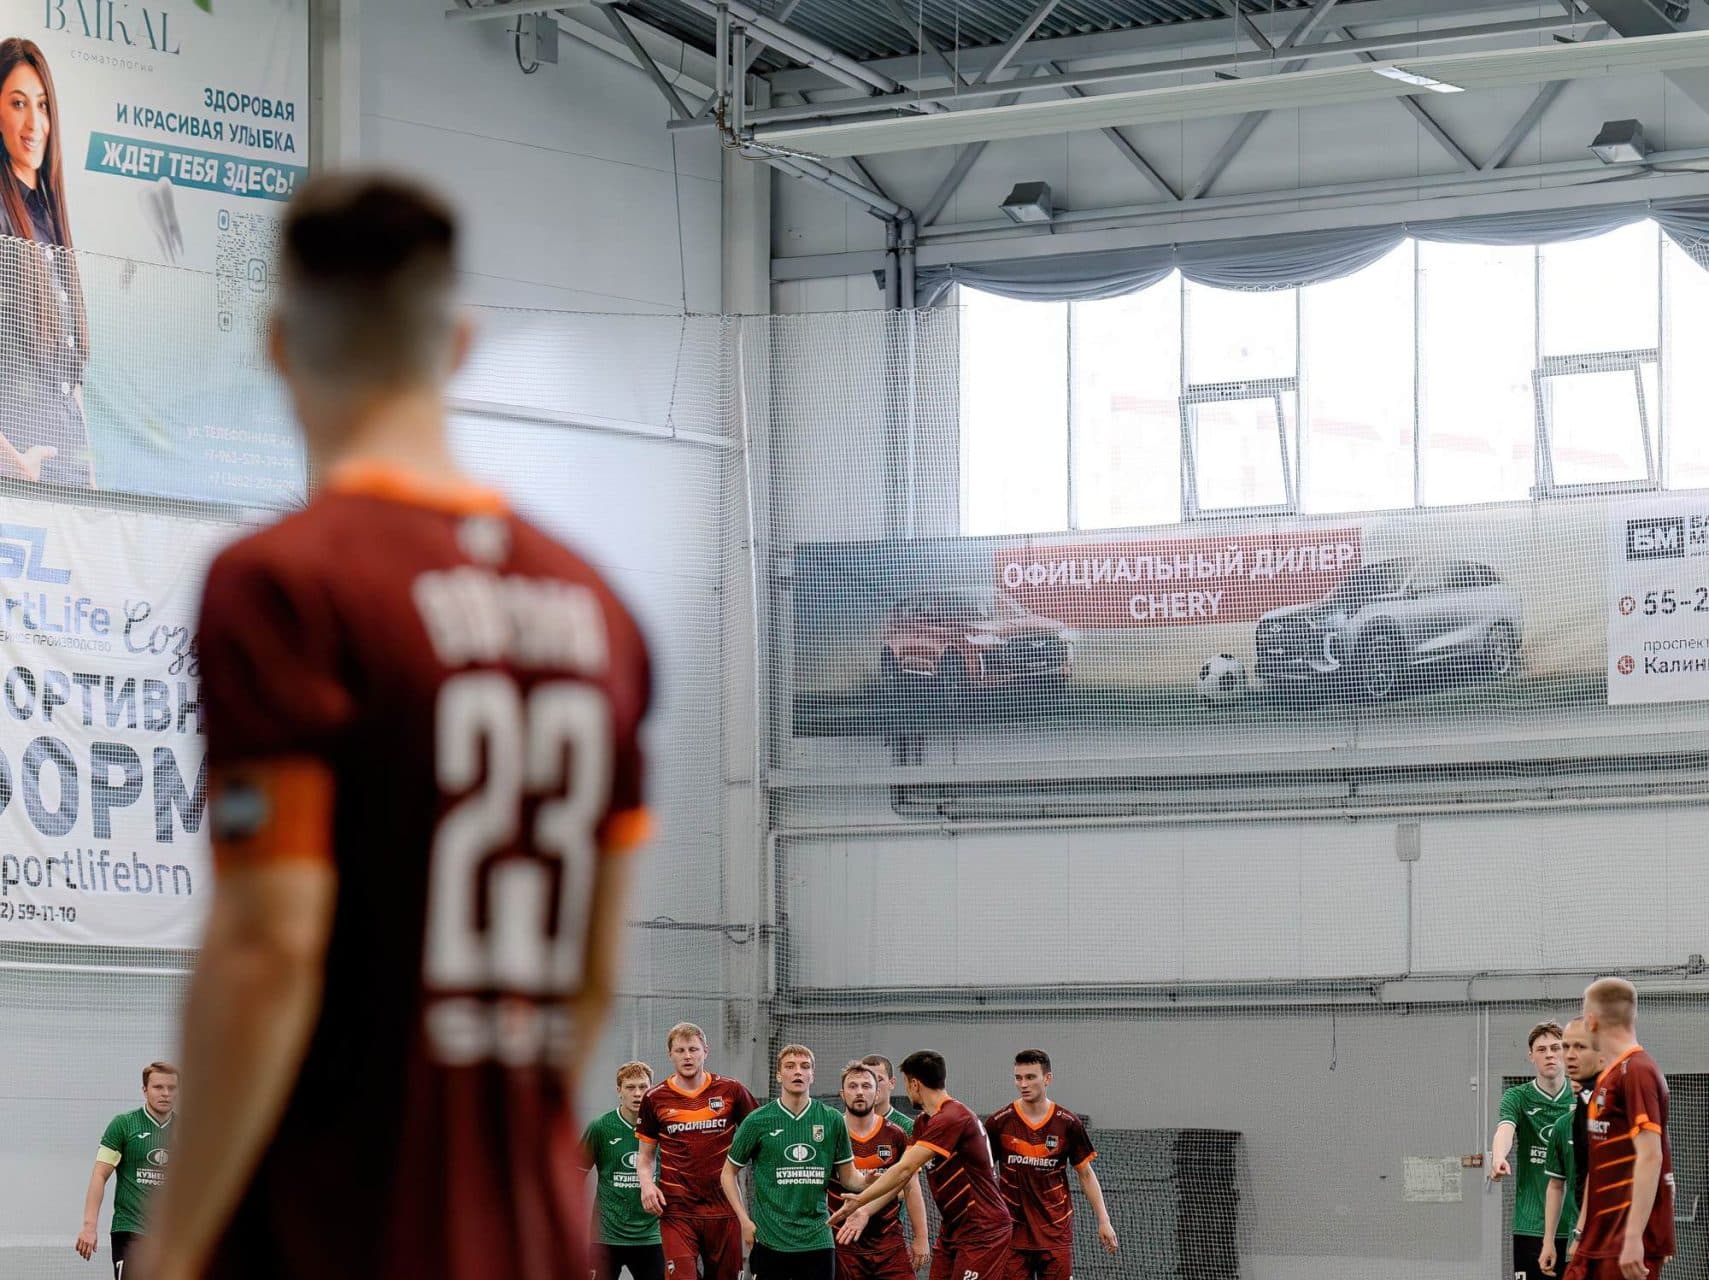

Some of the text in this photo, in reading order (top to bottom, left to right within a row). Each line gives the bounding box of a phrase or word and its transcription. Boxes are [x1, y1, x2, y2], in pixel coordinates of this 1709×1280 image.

[70, 50, 154, 72] стоматология
[204, 88, 295, 122] ЗДОРОВАЯ
[116, 103, 296, 153] И КРАСИВАЯ УЛЫБКА
[101, 141, 295, 195] ЖДЕТ ТЕБЯ ЗДЕСЬ!
[1003, 544, 1353, 589] ОФИЦИАЛЬНЫЙ ДИЛЕР
[1129, 591, 1223, 620] CHERY
[33, 634, 112, 653] ПРОИЗВОДСТВО
[1645, 657, 1709, 674] Калин
[2, 848, 192, 896] portlifebrn
[18, 903, 76, 923] 59-11-10
[667, 1119, 727, 1134] ПРОДИНВЕСТ
[1008, 1155, 1058, 1167] ПРОДИНВЕСТ
[776, 1170, 824, 1178] КУЗНЕЦКИЕ
